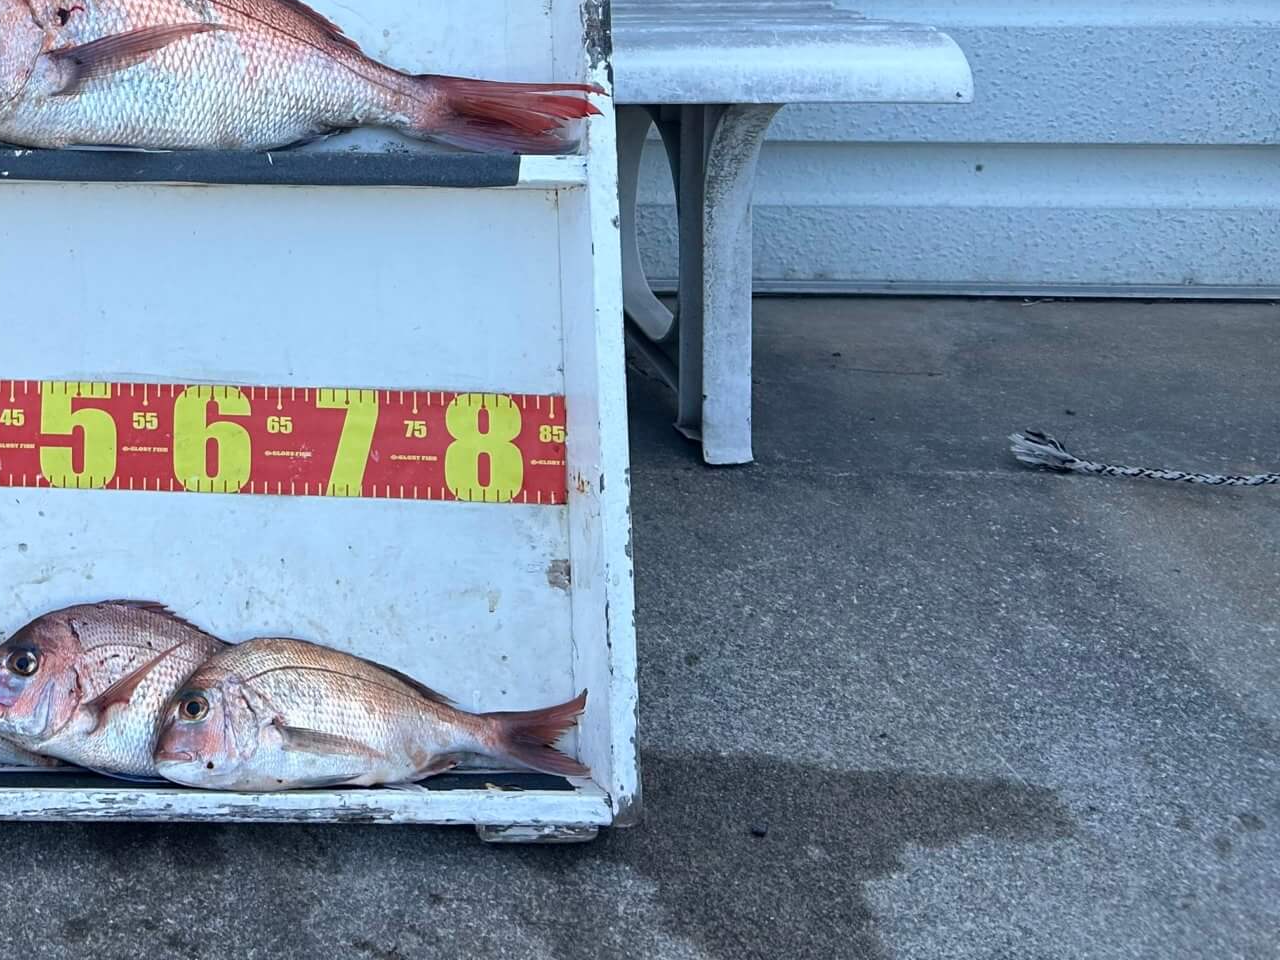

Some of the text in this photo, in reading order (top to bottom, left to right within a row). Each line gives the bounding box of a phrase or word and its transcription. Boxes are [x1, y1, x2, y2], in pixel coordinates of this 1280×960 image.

[0, 408, 25, 427] 45
[132, 411, 158, 430] 55
[266, 415, 293, 434] 65
[404, 419, 427, 438] 75
[539, 424, 565, 443] 85
[39, 380, 118, 489] 5
[173, 384, 252, 493] 6
[315, 387, 379, 497] 7
[444, 392, 524, 503] 8
